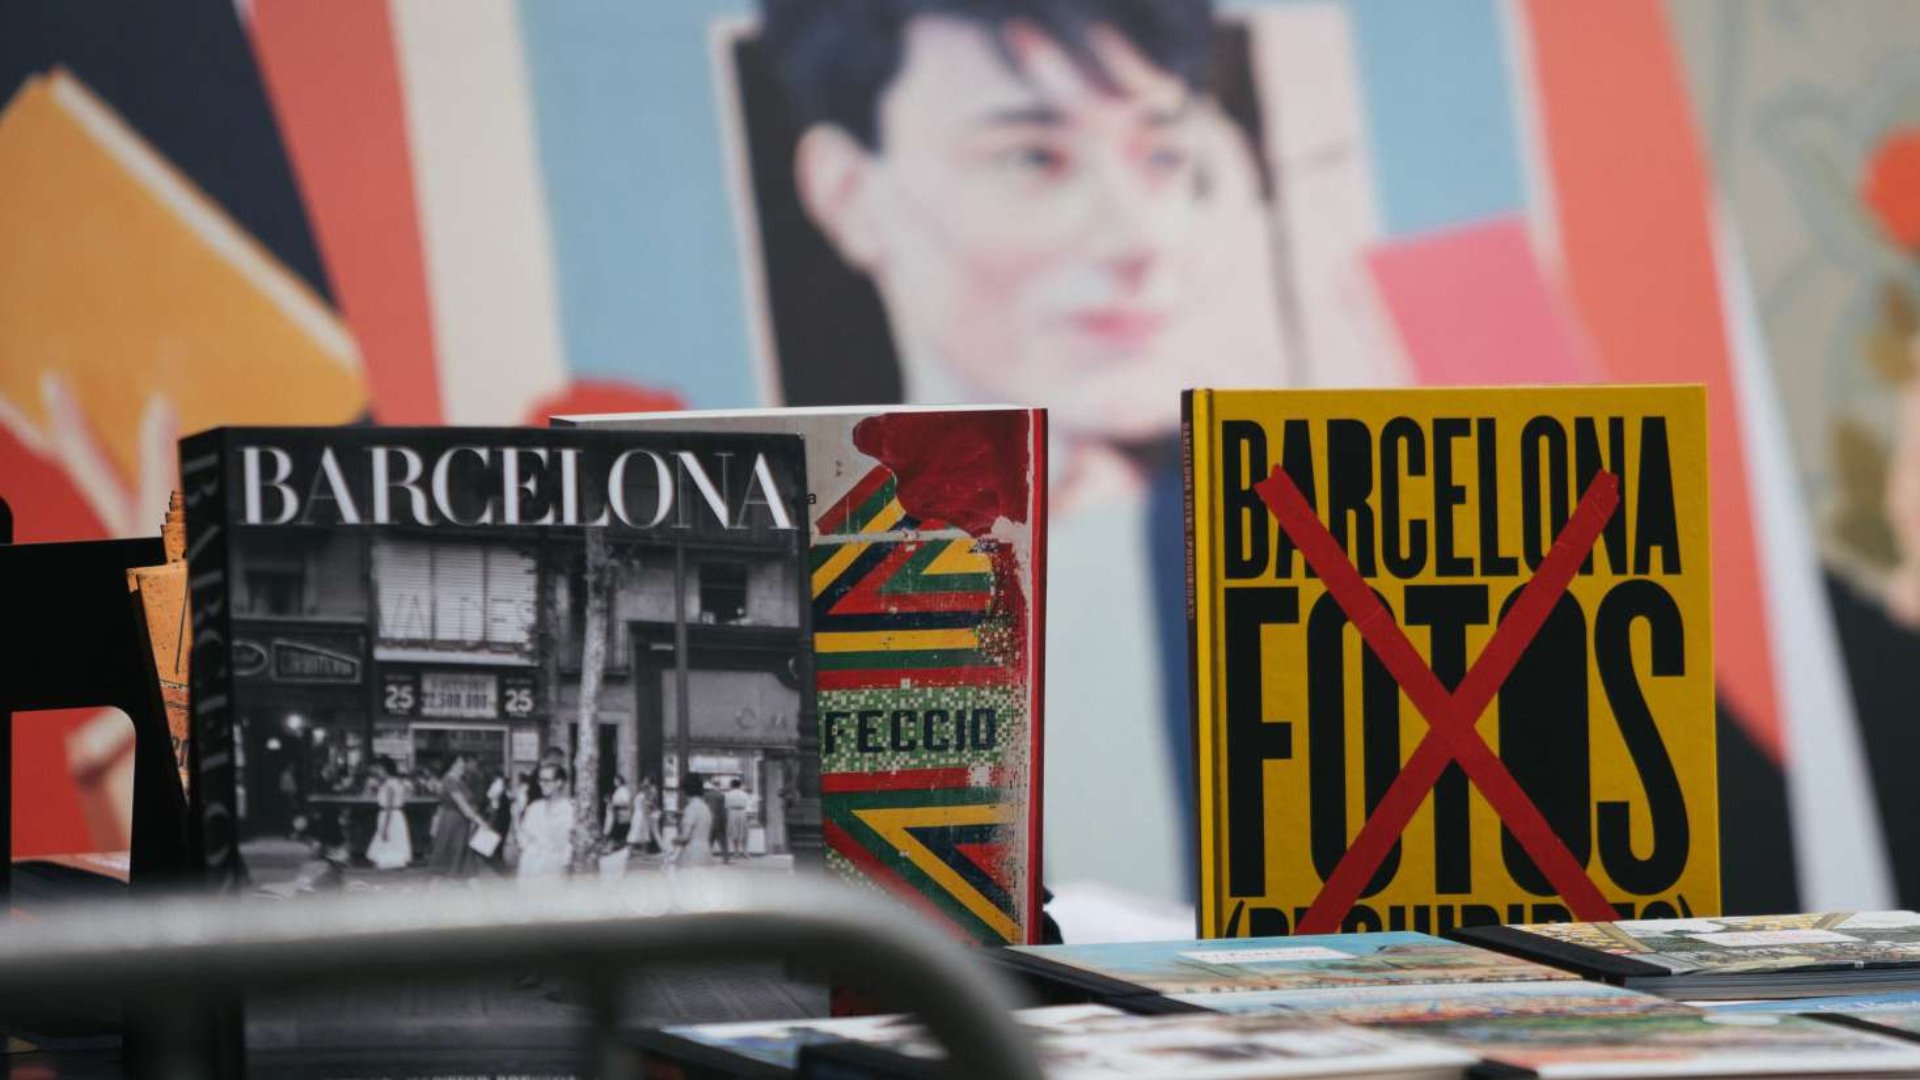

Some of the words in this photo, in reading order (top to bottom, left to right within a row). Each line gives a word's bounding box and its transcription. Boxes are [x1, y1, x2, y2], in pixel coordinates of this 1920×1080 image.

[238, 446, 798, 530] BARCELONA
[1221, 415, 1683, 580] BARCELONA
[183, 451, 230, 869] BARCELO
[385, 684, 415, 709] 25
[505, 688, 534, 713] 25
[1224, 579, 1691, 898] FOTOS
